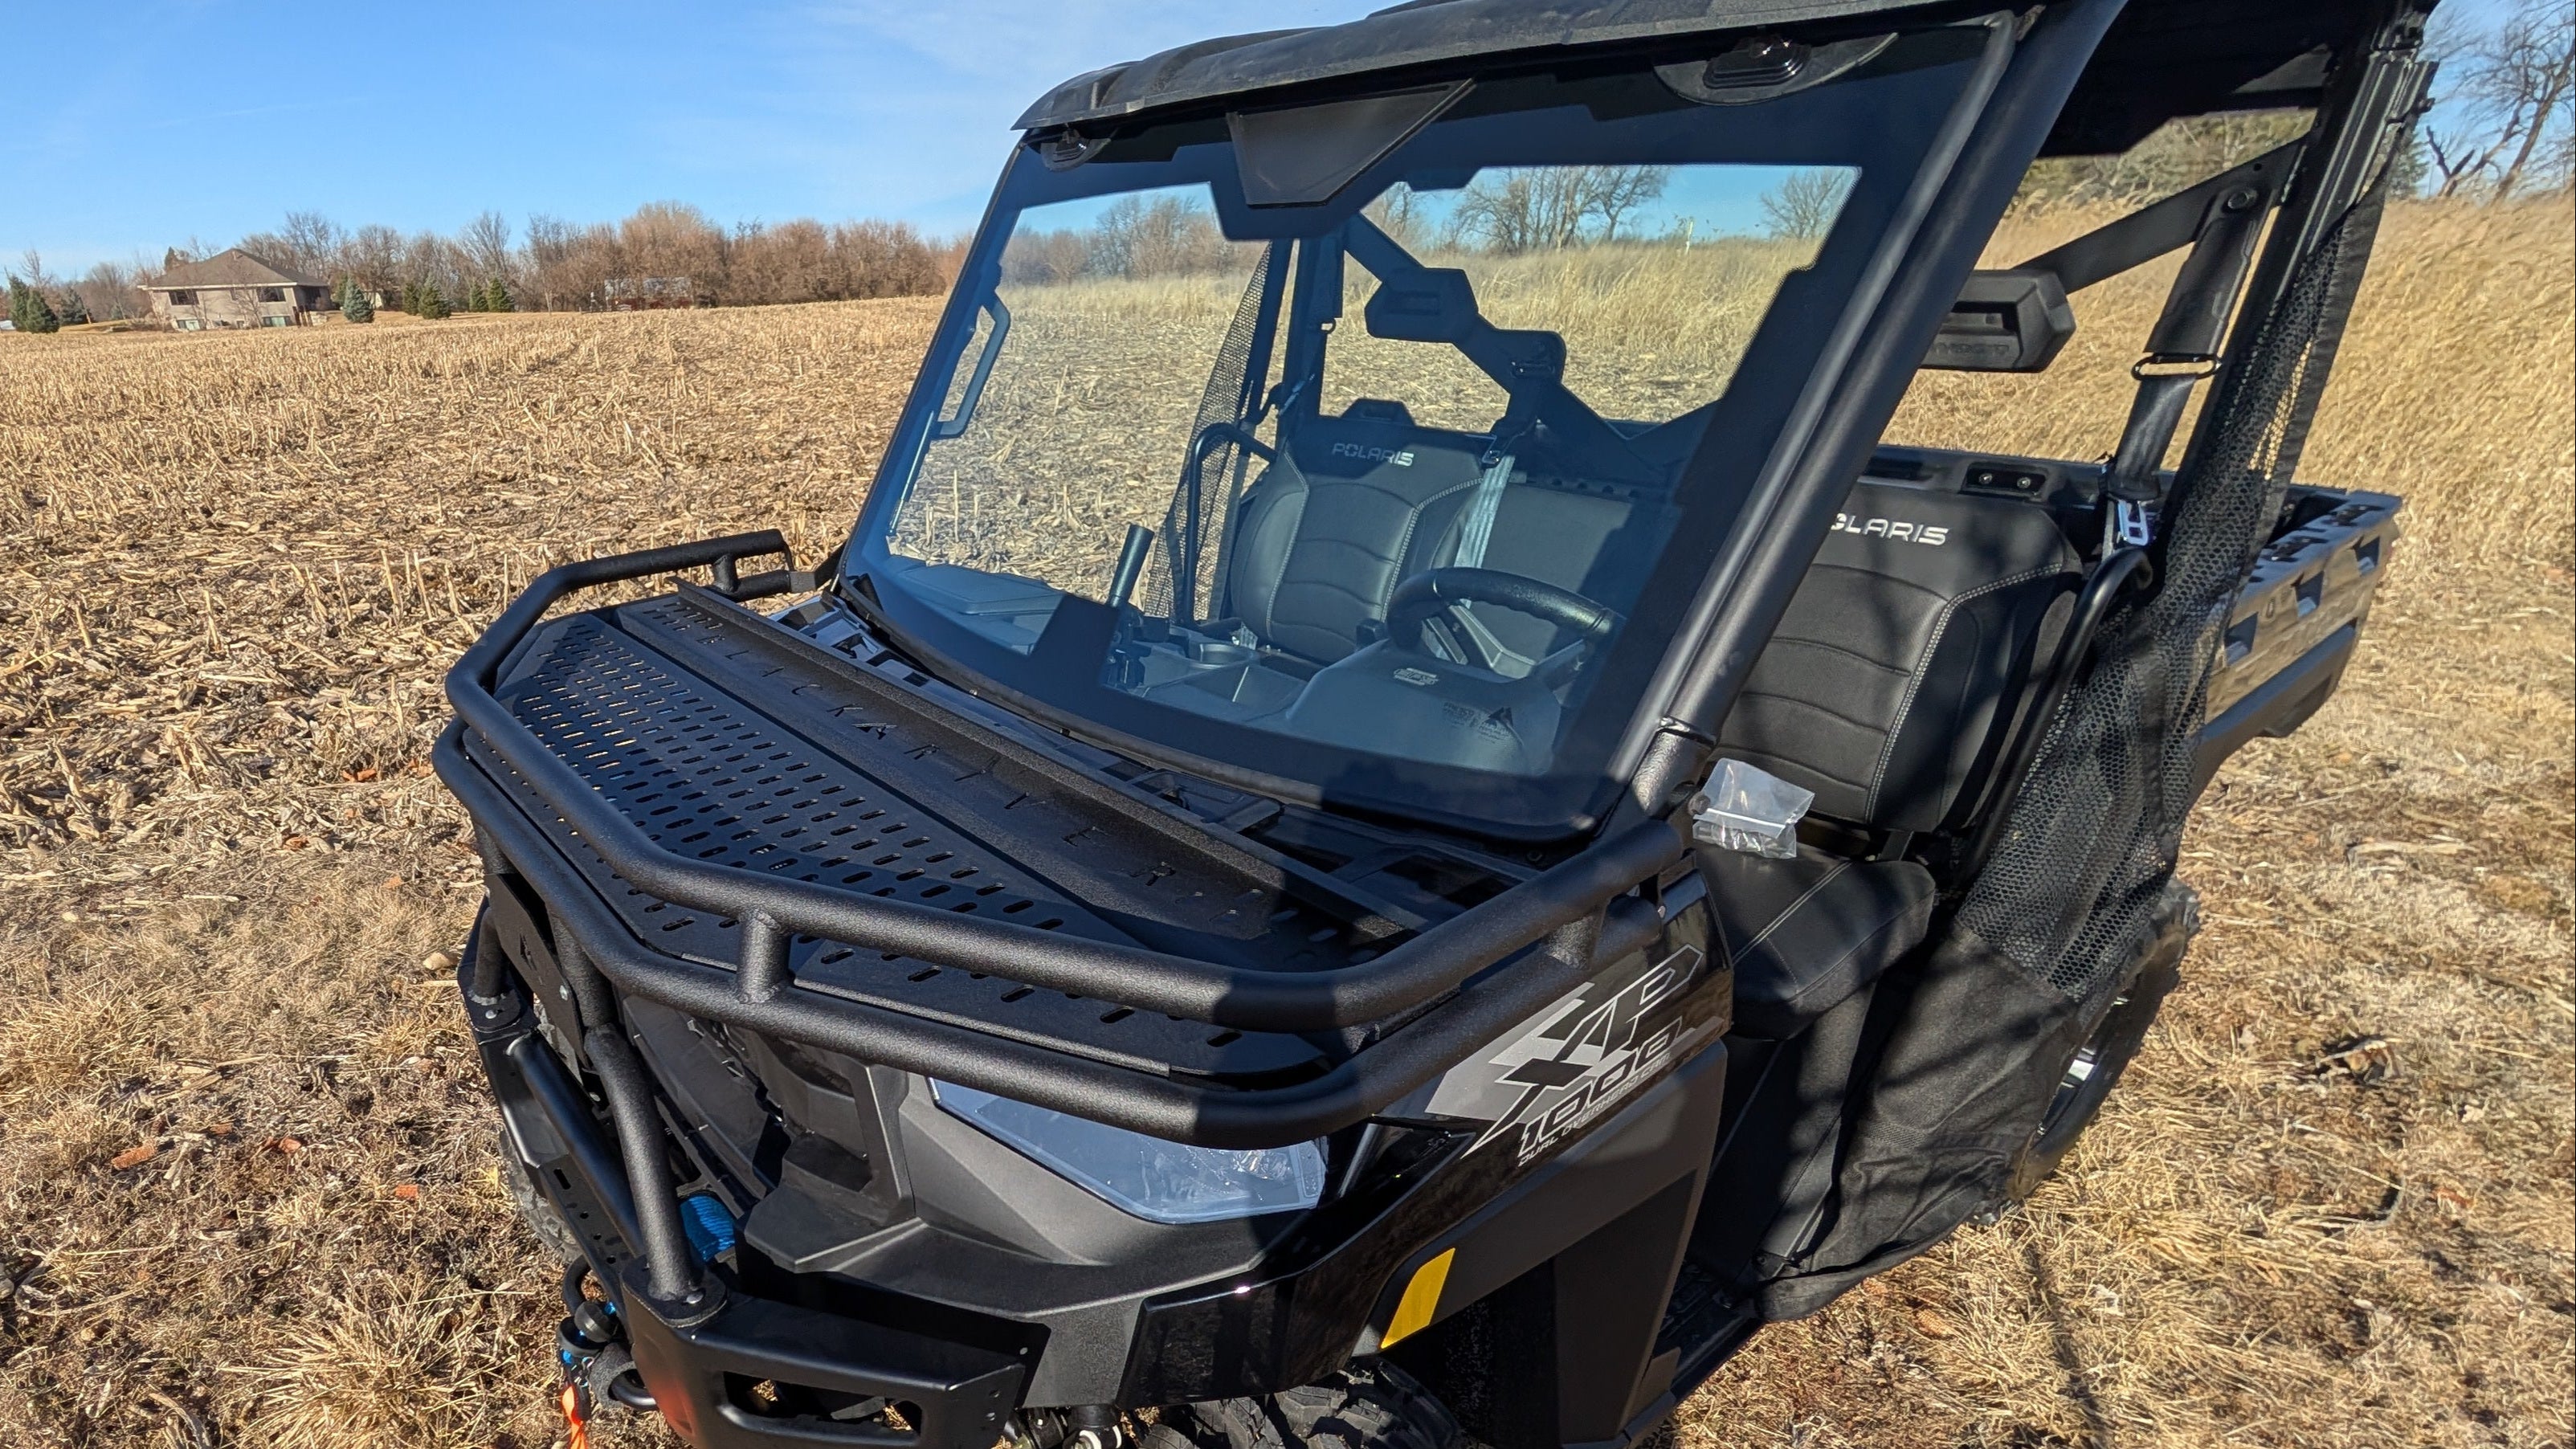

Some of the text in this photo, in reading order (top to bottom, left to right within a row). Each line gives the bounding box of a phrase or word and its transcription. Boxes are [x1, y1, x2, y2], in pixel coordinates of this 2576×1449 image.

[1332, 443, 1415, 467] POLARIS
[1830, 512, 1949, 546] OLARIS
[1460, 943, 1704, 1159] XP
[1517, 1015, 1682, 1158] 1000
[1518, 1051, 1672, 1167] DUAL OVERHEAD CAM
